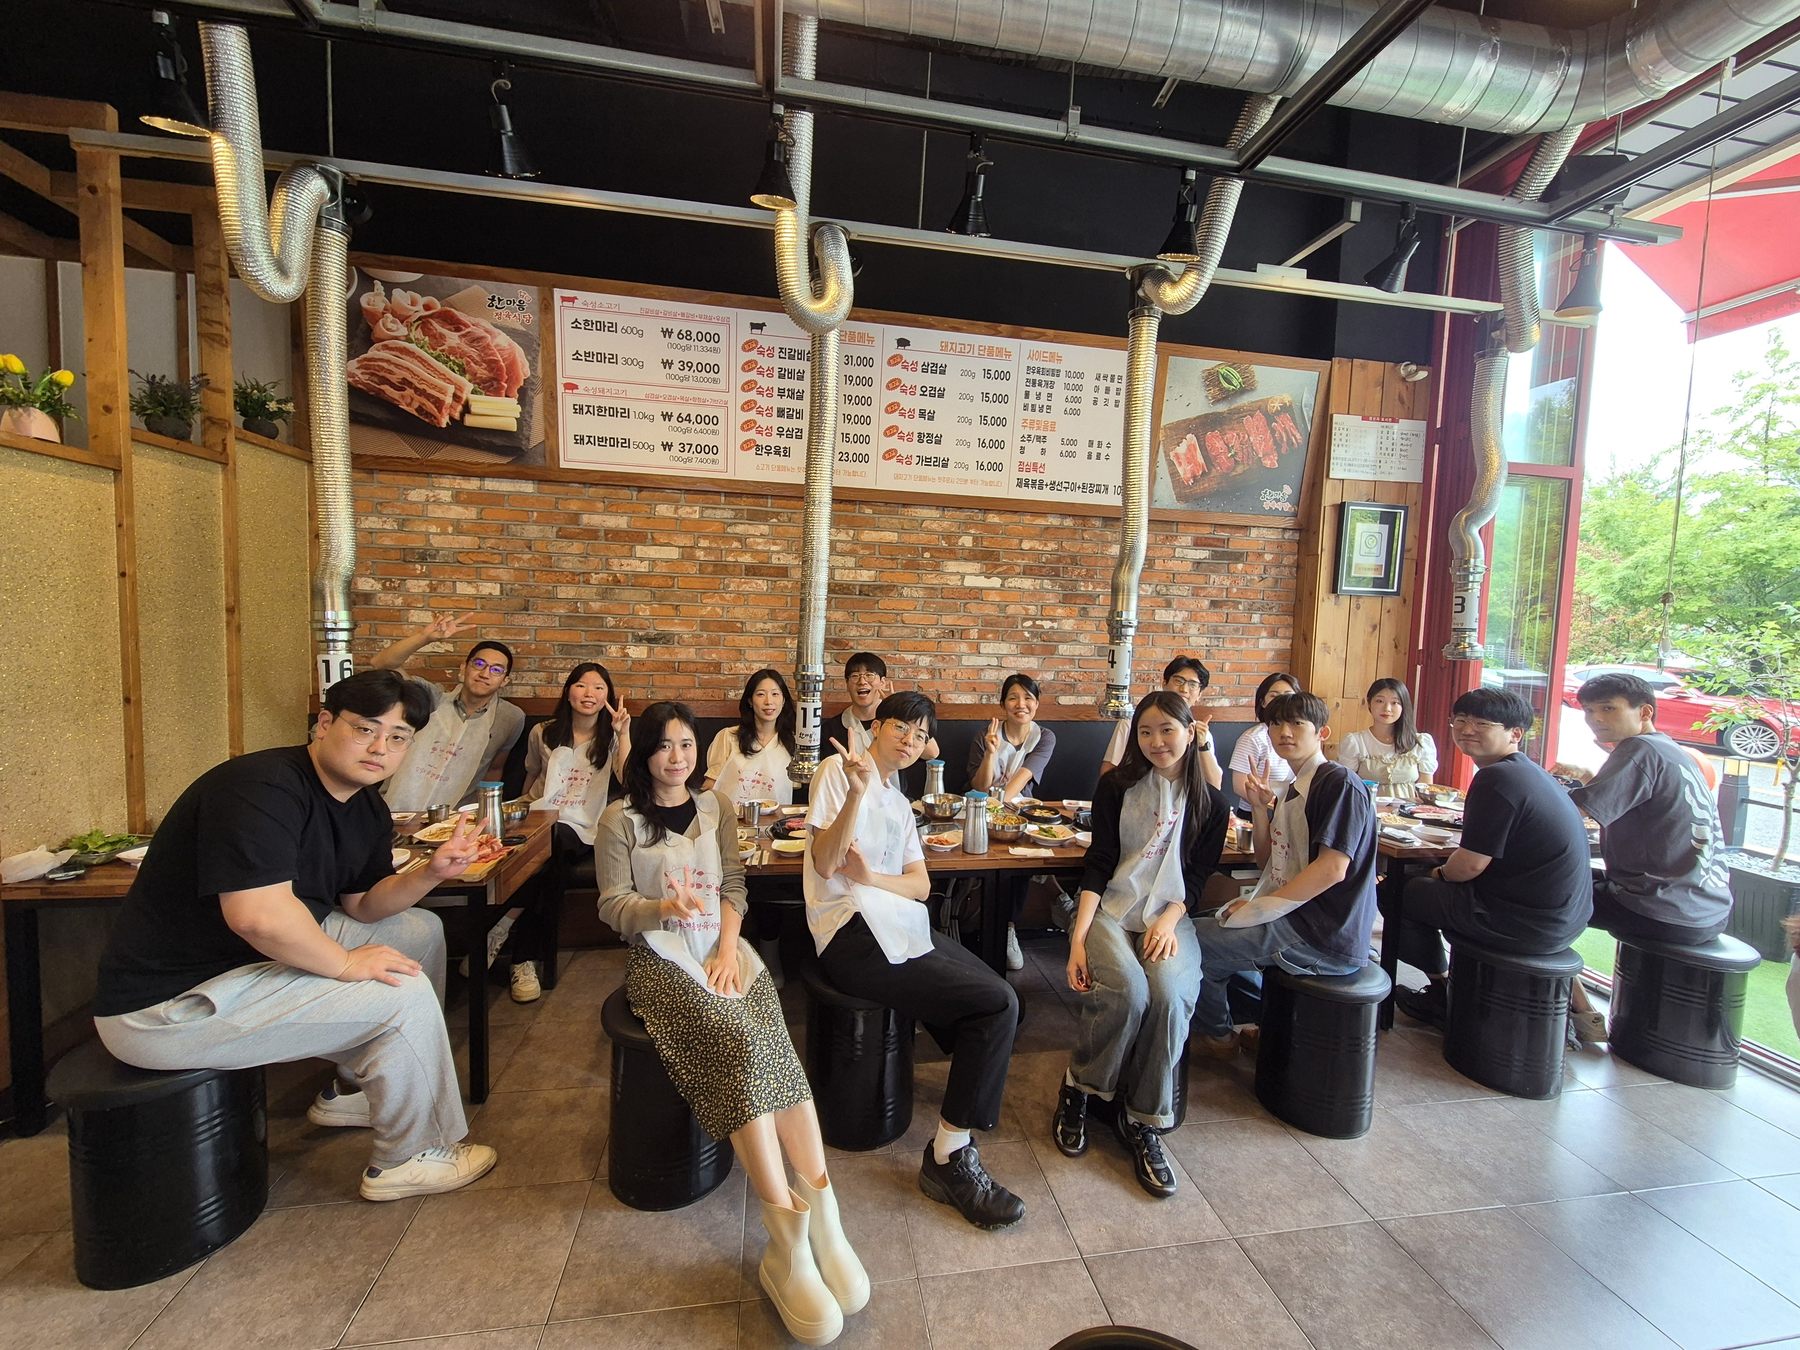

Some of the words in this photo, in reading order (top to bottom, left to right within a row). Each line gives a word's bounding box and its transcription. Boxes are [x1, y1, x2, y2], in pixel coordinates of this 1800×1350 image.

[487, 294, 527, 311] 한마음
[581, 300, 620, 311] 숙성소고기
[495, 311, 532, 324] 정육식당
[571, 318, 618, 334] 소한마리
[621, 325, 644, 339] 600g
[677, 329, 721, 344] 68,000
[572, 350, 619, 366] 소반마리
[621, 356, 644, 369] 300g
[756, 345, 775, 359] 숙성
[844, 355, 874, 368] 31,000
[940, 340, 976, 355] 돼지고기
[978, 345, 1013, 360] 단품메뉴
[1027, 349, 1063, 365] 사이드메뉴
[678, 360, 721, 375] 39,000
[756, 365, 775, 379] 숙성
[778, 367, 805, 382] 갈비살
[844, 375, 874, 388] 19,000
[901, 360, 919, 373] 숙성
[921, 362, 947, 376] 삼겹살
[960, 369, 976, 379] 200g
[983, 369, 1011, 382] 15,000
[1065, 370, 1085, 380] 10,000
[900, 384, 917, 396] 숙성
[920, 386, 946, 399] 오겹살
[959, 393, 974, 403] 200g
[981, 392, 1009, 405] 15,000
[1025, 378, 1056, 390] 전통육개장
[1064, 383, 1084, 392] 10,000
[756, 385, 774, 399] 숙성
[777, 387, 805, 401] 부채살
[843, 394, 873, 407] 19,000
[1065, 395, 1082, 405] 6,000
[573, 404, 631, 420] 돼지한마리
[633, 410, 655, 423] 1.0kg
[677, 413, 720, 427] 64,000
[756, 405, 774, 418] 숙성
[842, 414, 872, 426] 19,000
[898, 407, 916, 420] 숙성
[919, 409, 936, 422] 목살
[957, 416, 973, 426] 200g
[979, 415, 1007, 428] 15,000
[1064, 408, 1081, 417] 6,000
[574, 434, 631, 450] 돼지반마리
[633, 441, 655, 453] 500g
[755, 425, 773, 438] 숙성
[776, 427, 803, 440] 우삼겹
[841, 433, 871, 445] 15,000
[897, 431, 915, 443] 숙성
[917, 432, 943, 446] 항정살
[956, 439, 971, 449] 200g
[978, 438, 1005, 450] 16,000
[1020, 434, 1047, 445] 소주/맥주
[1061, 438, 1078, 447] 5,000
[679, 443, 719, 456] 37,000
[755, 444, 791, 458] 한우육회
[838, 452, 870, 464] 23,000
[1060, 450, 1077, 459] 6,000
[896, 454, 913, 466] 숙성
[916, 455, 950, 469] 가브리살
[954, 462, 969, 471] 200g
[976, 461, 1004, 473] 16,000
[1018, 461, 1046, 474] 점심특선
[1454, 596, 1466, 614] 3
[1108, 649, 1117, 669] 4
[322, 659, 353, 683] 16
[801, 707, 822, 728] 15
